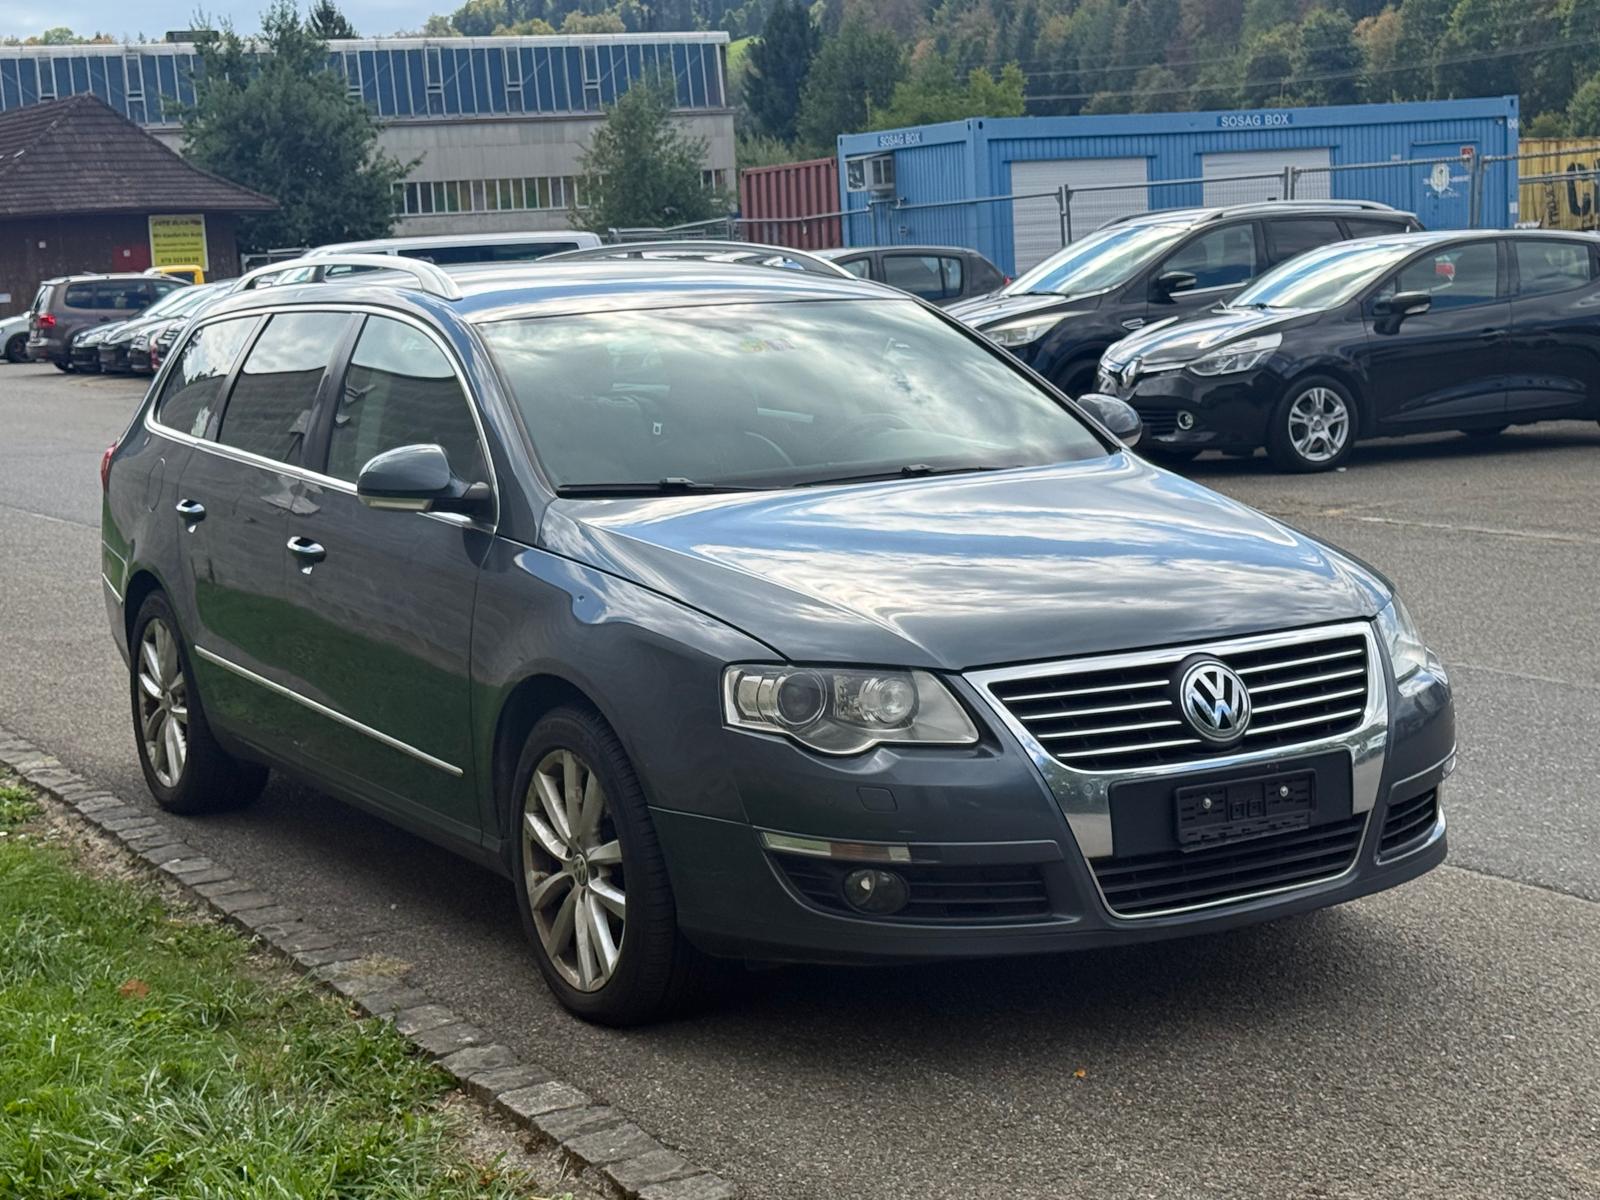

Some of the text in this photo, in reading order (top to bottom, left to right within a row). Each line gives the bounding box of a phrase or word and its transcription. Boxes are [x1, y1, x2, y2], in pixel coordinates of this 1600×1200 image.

[1221, 113, 1289, 127] SOSAG BOX
[880, 132, 921, 147] SOSAG BOX
[1180, 660, 1251, 741] VW
